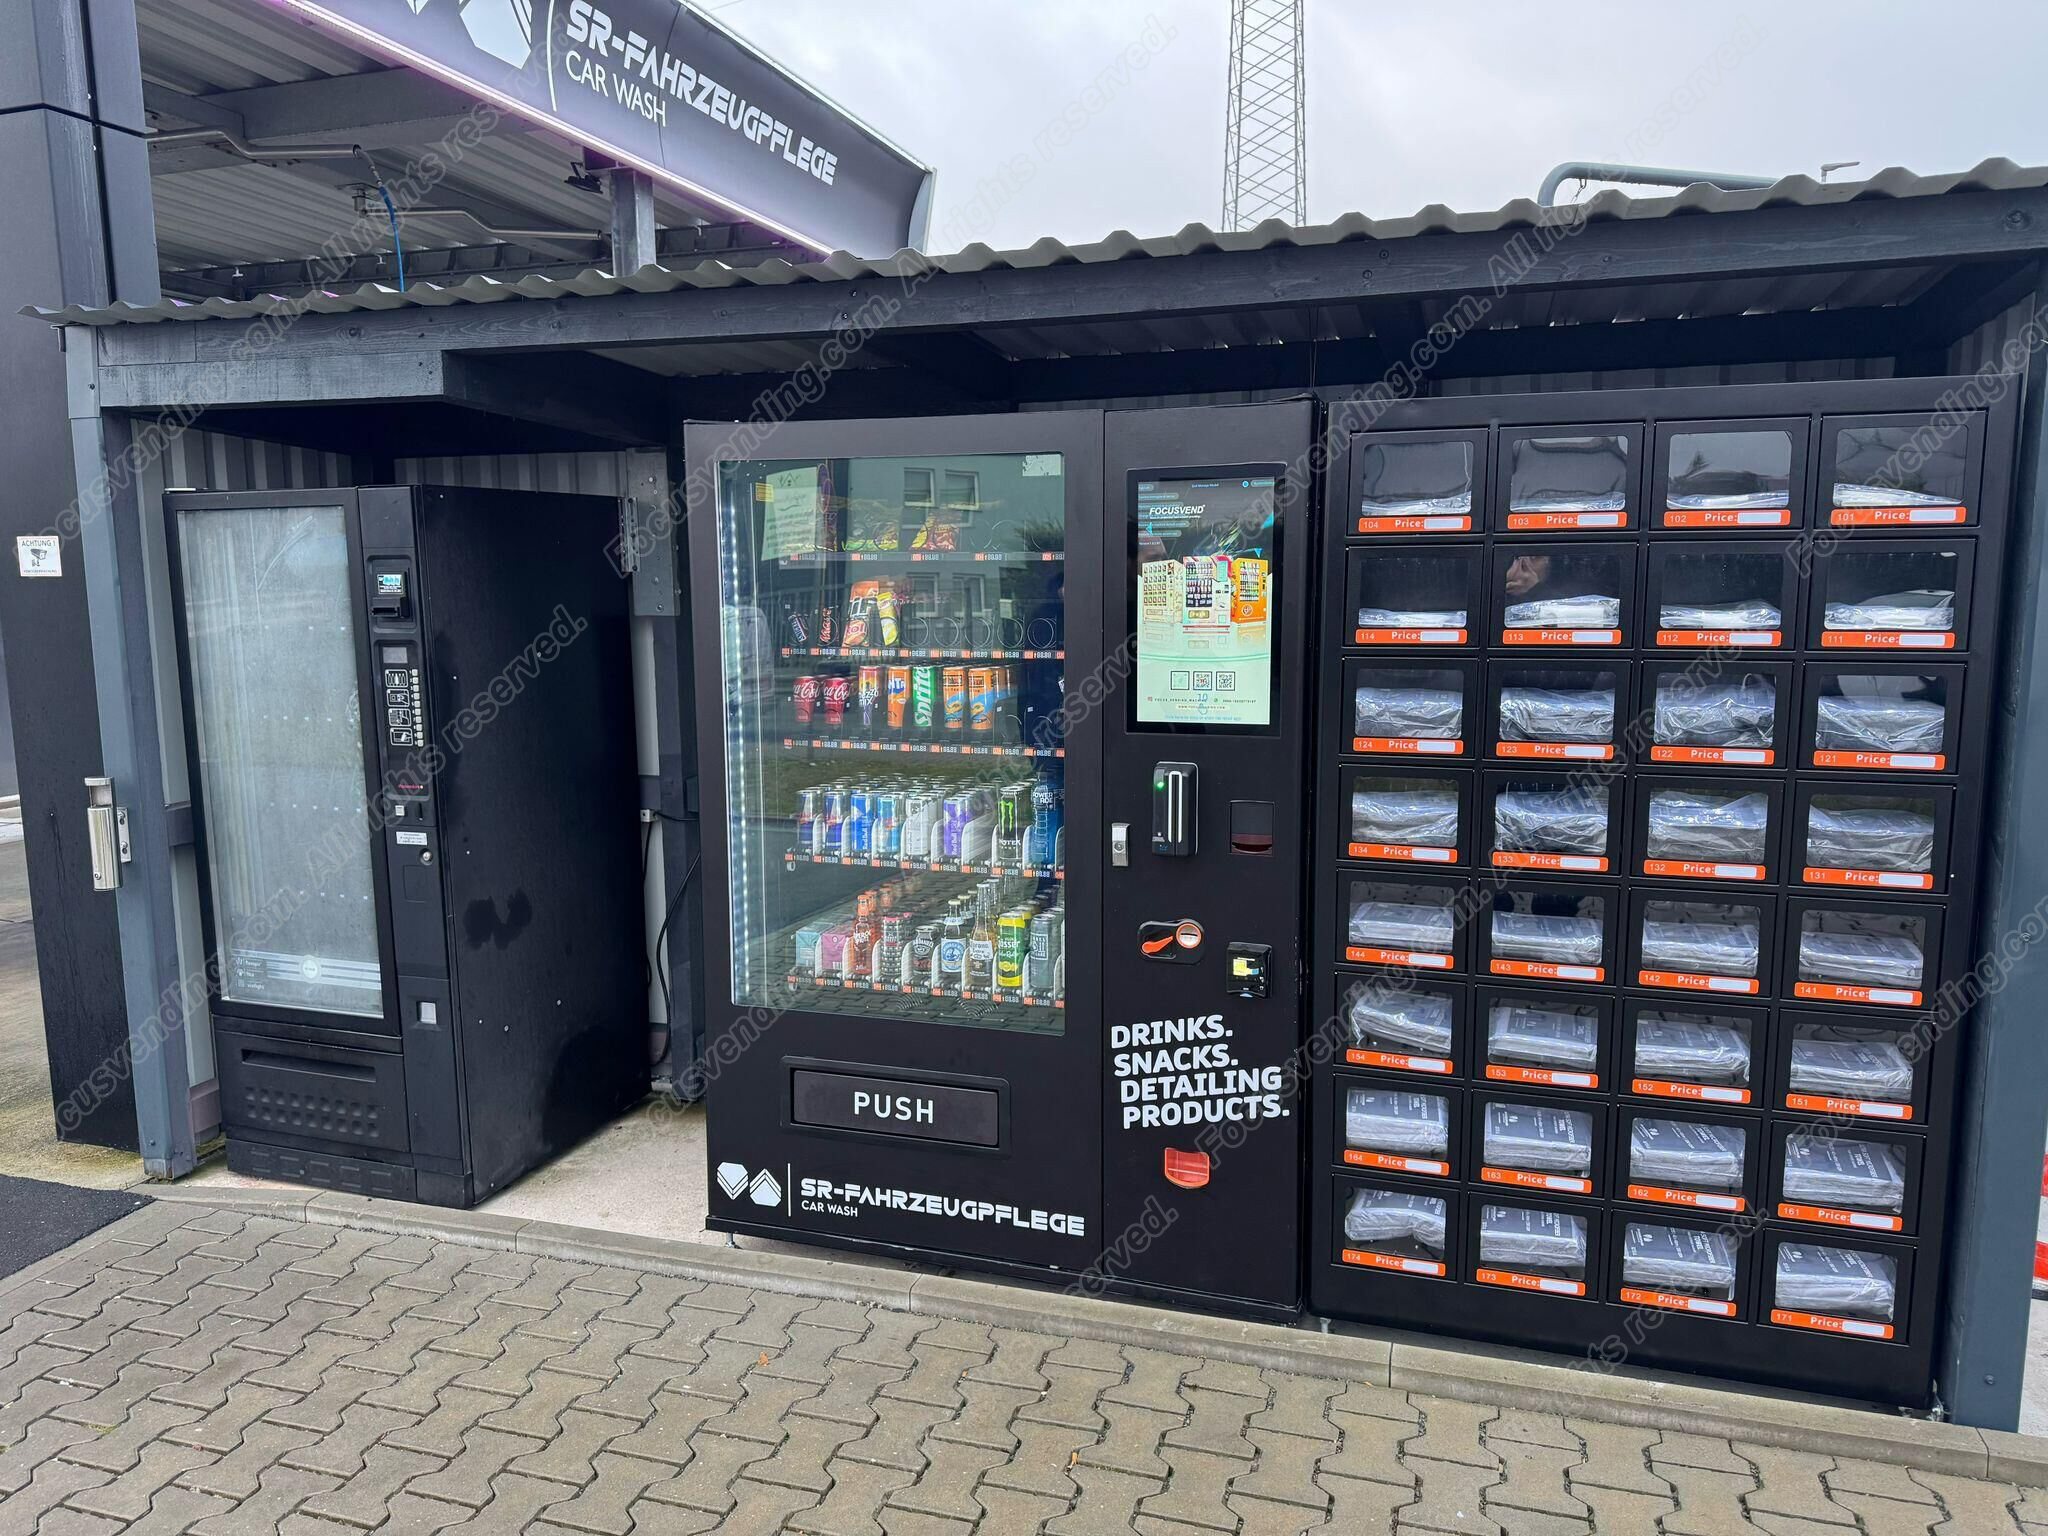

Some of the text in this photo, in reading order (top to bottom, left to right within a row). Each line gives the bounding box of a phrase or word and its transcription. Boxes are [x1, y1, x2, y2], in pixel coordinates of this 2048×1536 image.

[566, 50, 666, 127] CAR WASH
[567, 0, 838, 186] SR-FAHRZEUGPFLEGE
[1149, 505, 1204, 515] FOCUSVEND
[1837, 510, 1910, 522] 101 Price:
[1363, 519, 1423, 529] 104 Price:
[1512, 515, 1578, 526] 103 Price:
[1670, 513, 1738, 525] 102 Price:
[1361, 631, 1420, 640] 114 Price:
[1509, 631, 1573, 642] 113 Price:
[1664, 633, 1729, 644] 112 Price:
[1828, 633, 1899, 644] 111 Price:
[1358, 740, 1417, 751] 124 Price:
[1502, 743, 1565, 756] 123 Price:
[1658, 749, 1723, 760] 122 Price:
[1819, 752, 1891, 766] 121 Price:
[1355, 846, 1411, 858] 134 Price:
[1498, 855, 1560, 865] 133 Price:
[1651, 861, 1715, 875] 132 Price:
[1810, 869, 1880, 884] 131 Price:
[1352, 950, 1410, 963] 144 Price:
[1497, 964, 1557, 976] 143 Price:
[1645, 975, 1709, 988] 142 Price:
[1801, 986, 1870, 1000] 141 Price:
[1111, 1013, 1234, 1050] DRINKS.
[1113, 1043, 1239, 1077] SNACKS.
[1352, 1053, 1410, 1067] 154 Price:
[1492, 1069, 1551, 1082] 153 Price:
[1121, 1067, 1283, 1103] DETAILING
[1639, 1083, 1704, 1097] 152 Price:
[853, 1091, 935, 1124] PUSH
[1123, 1094, 1290, 1129] PRODUCTS.
[1792, 1097, 1859, 1112] 151 Price:
[1349, 1152, 1407, 1169] 164 Price:
[1487, 1171, 1546, 1186] 163 Price:
[1634, 1188, 1695, 1202] 162 Price:
[801, 1177, 1085, 1237] SR-FAHRZEUGPFLEGE
[801, 1202, 859, 1218] CAR WASH
[1784, 1206, 1851, 1223] 161 Price:
[1348, 1252, 1403, 1268] 174 Price:
[1483, 1274, 1541, 1288] 173 Price:
[1626, 1291, 1689, 1307] 172 Price:
[1777, 1314, 1842, 1330] 171 Price:
